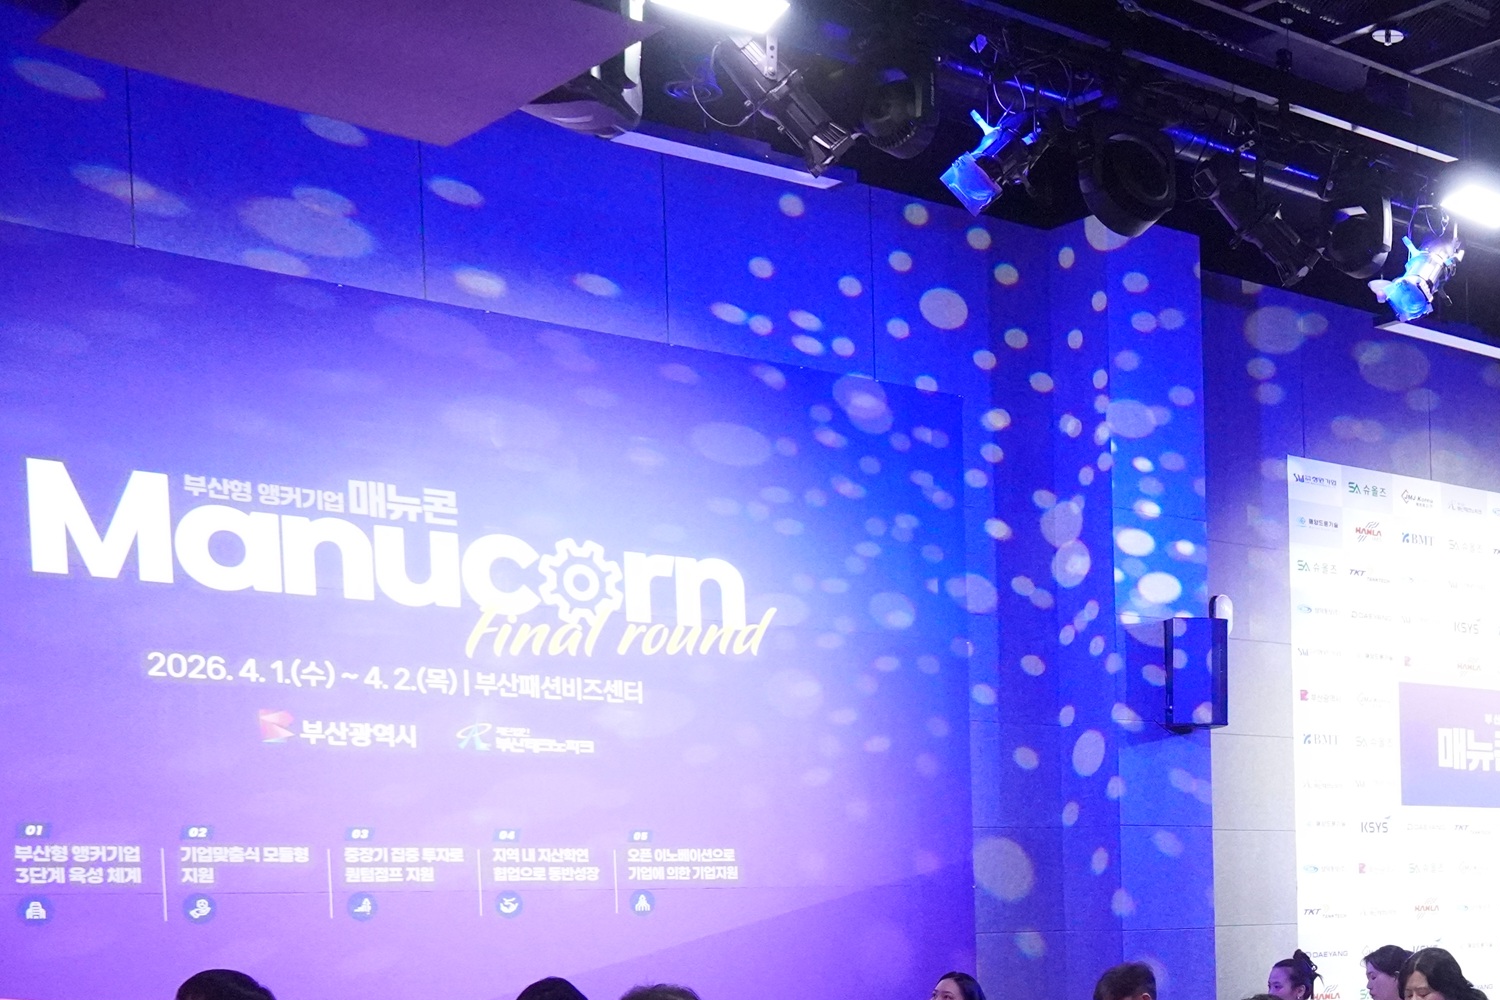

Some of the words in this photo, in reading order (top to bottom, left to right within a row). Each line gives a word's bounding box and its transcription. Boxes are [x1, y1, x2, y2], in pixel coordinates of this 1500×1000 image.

[183, 474, 252, 502] 부산형
[257, 483, 344, 513] 앵커기업
[348, 479, 458, 526] 매뉴콘
[1411, 534, 1433, 546] BMT
[1349, 568, 1366, 577] TKT
[616, 606, 777, 657] round
[1454, 621, 1479, 635] KSYS
[147, 651, 234, 682] 2026.
[238, 658, 266, 683] 4.
[475, 671, 644, 704] 부산패션비즈센터
[300, 720, 418, 749] 부산광역시
[25, 825, 43, 836] 01
[188, 827, 208, 838] 02
[1361, 821, 1388, 833] KSYS
[15, 845, 68, 862] 부산형
[71, 845, 140, 862] 앵커기업
[15, 867, 66, 884] 3단계
[69, 867, 104, 884] 육성
[107, 867, 142, 884] 체계
[181, 867, 215, 884] 지원
